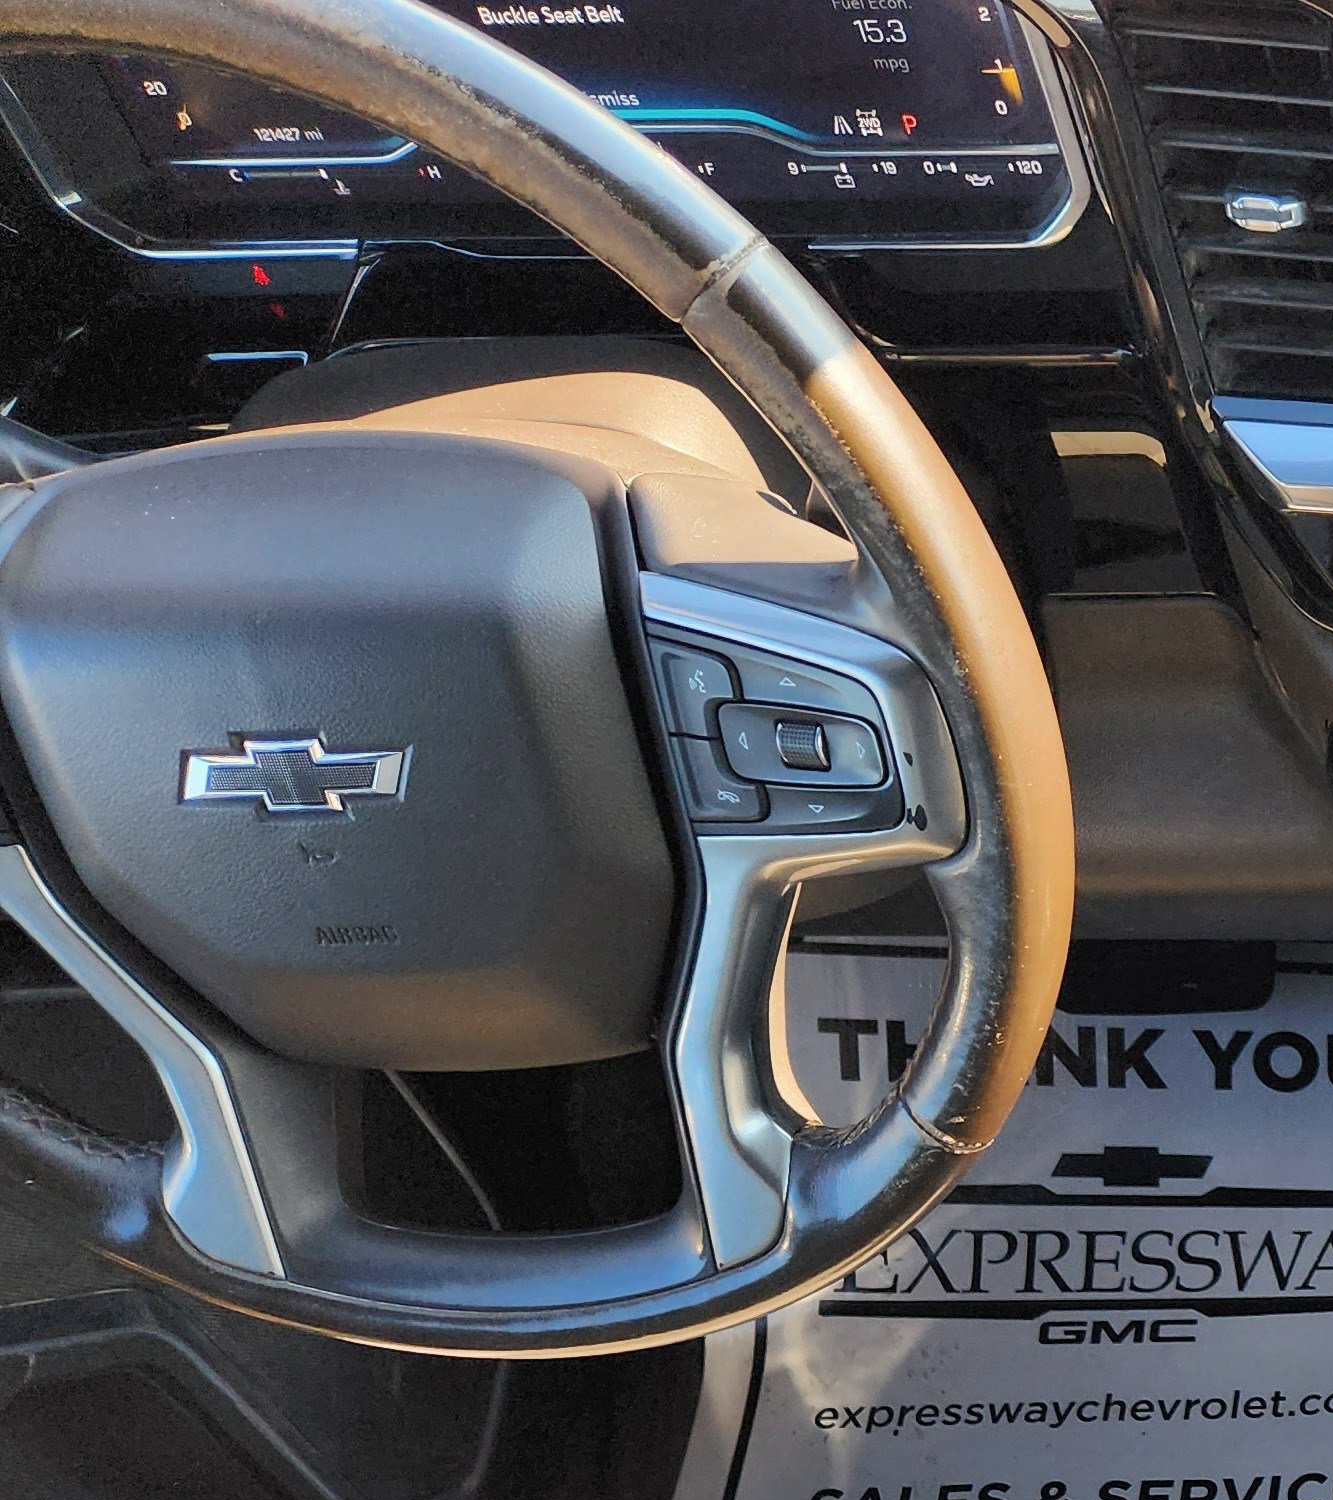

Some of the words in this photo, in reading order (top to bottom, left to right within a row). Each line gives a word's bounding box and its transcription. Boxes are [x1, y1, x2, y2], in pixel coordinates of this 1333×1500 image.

[476, 5, 540, 25] Buckle
[541, 6, 584, 24] Seat
[584, 4, 625, 24] Belt
[978, 7, 991, 22] 2
[852, 19, 908, 44] 15.3
[873, 58, 910, 73] mpg
[143, 80, 167, 96] 20
[994, 99, 1008, 116] 0
[902, 113, 917, 135] P
[253, 127, 300, 142] 121427
[303, 127, 324, 142] mi
[427, 165, 443, 181] H
[704, 162, 715, 176] F
[880, 161, 898, 175] 19
[1016, 161, 1043, 175] 120
[817, 1017, 1168, 1090] THNK
[1038, 1319, 1198, 1345] GMC
